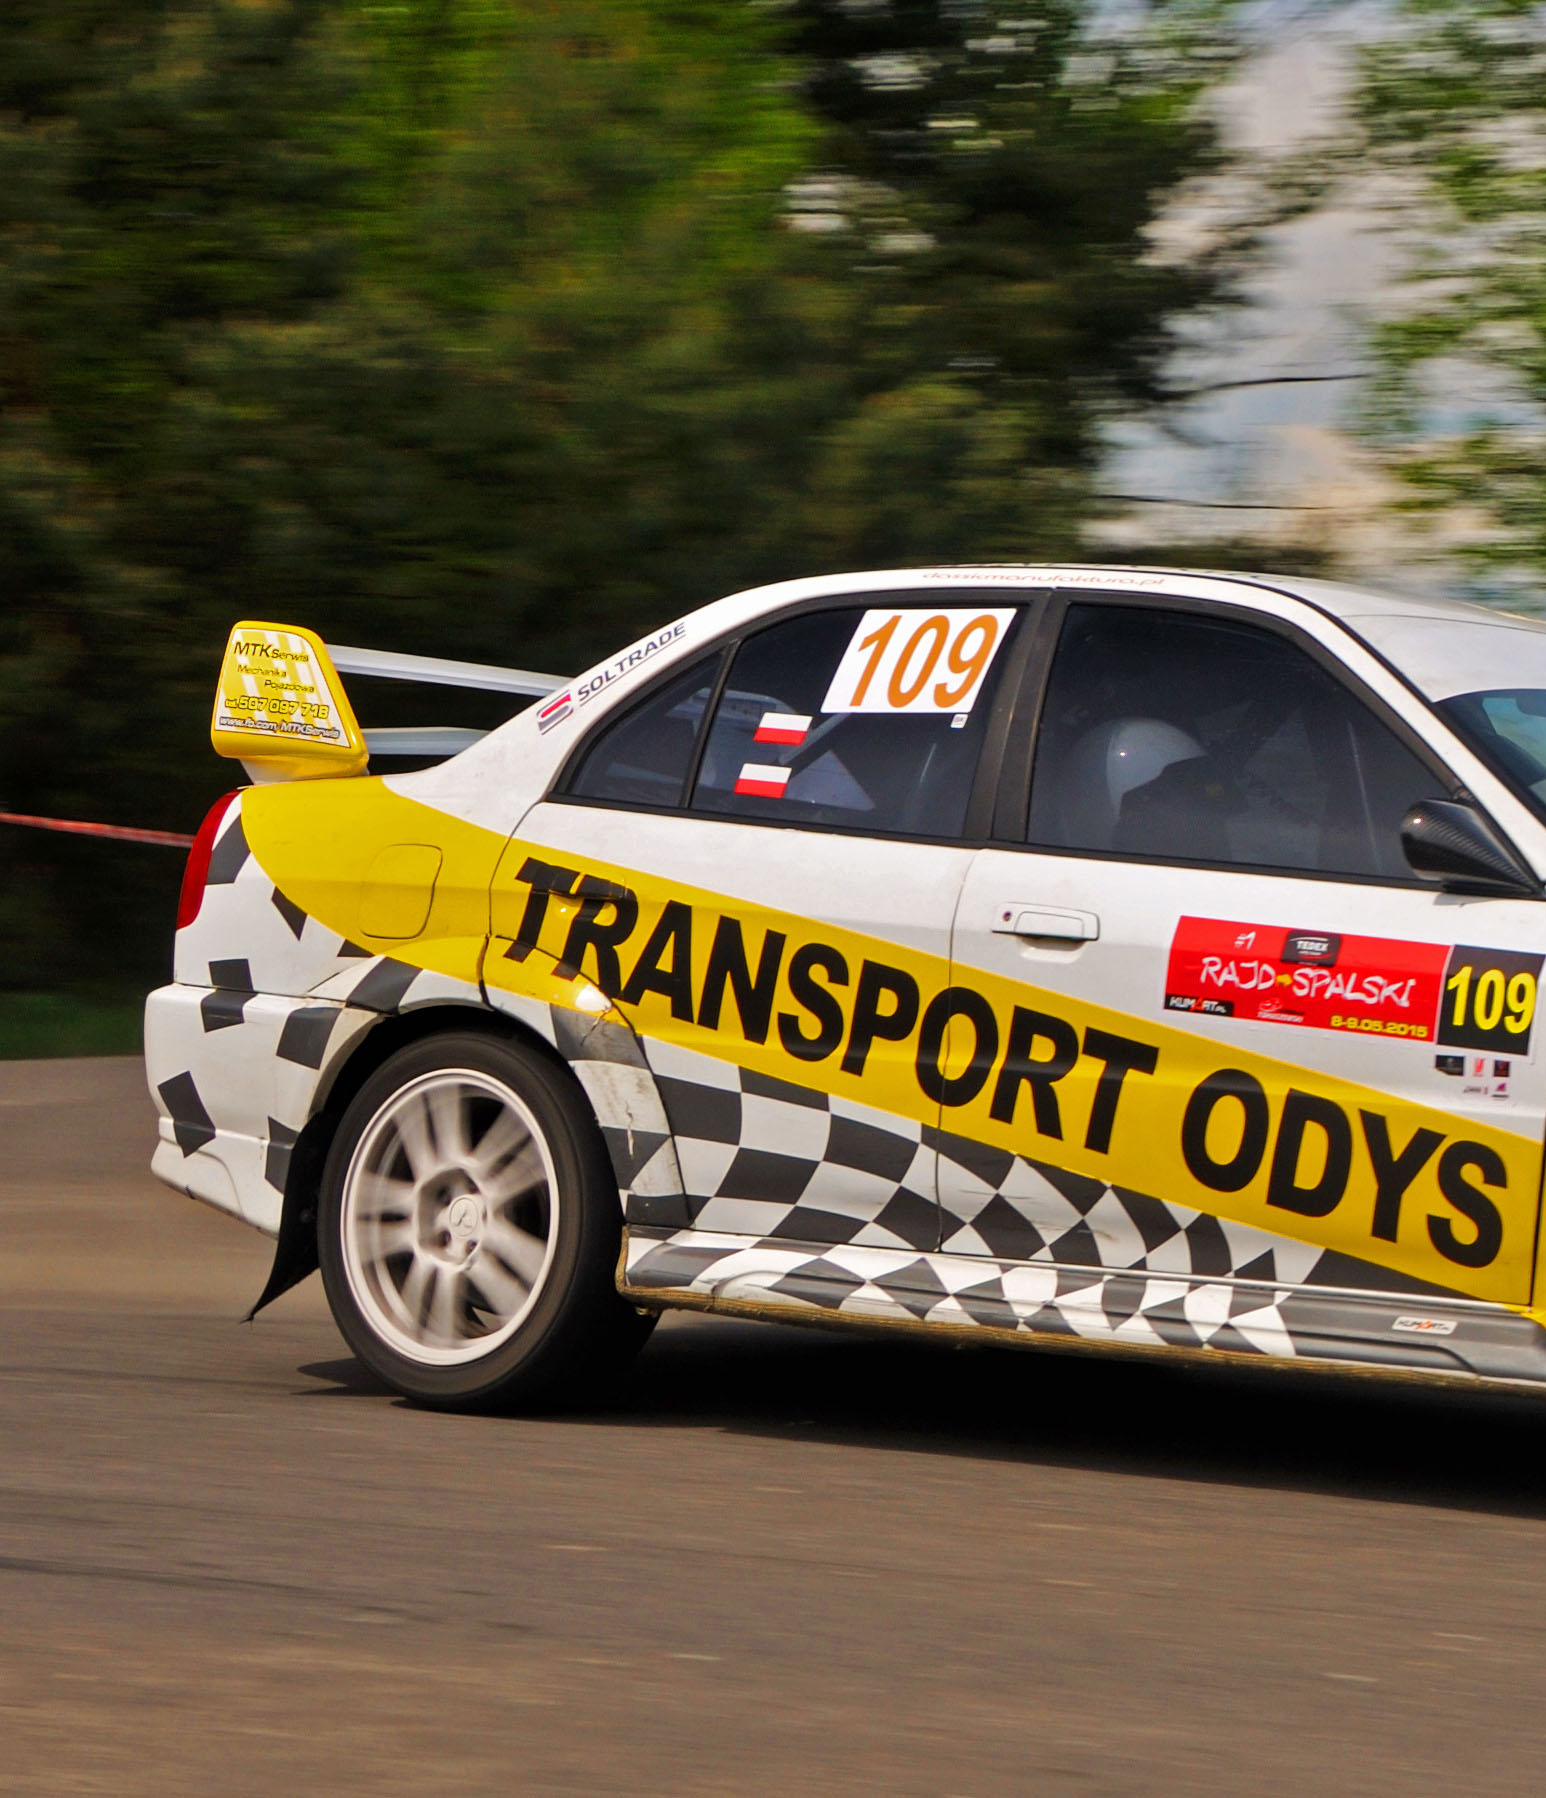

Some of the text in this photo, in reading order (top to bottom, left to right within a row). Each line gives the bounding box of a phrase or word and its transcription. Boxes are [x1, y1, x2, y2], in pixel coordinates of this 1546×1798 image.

[578, 622, 687, 703] SOLTRADE
[848, 614, 999, 709] 109
[1200, 957, 1416, 1008] RAJD SPALSKI
[1447, 966, 1536, 1034] 109
[500, 855, 1508, 1269] TRANSPORT ODYS
